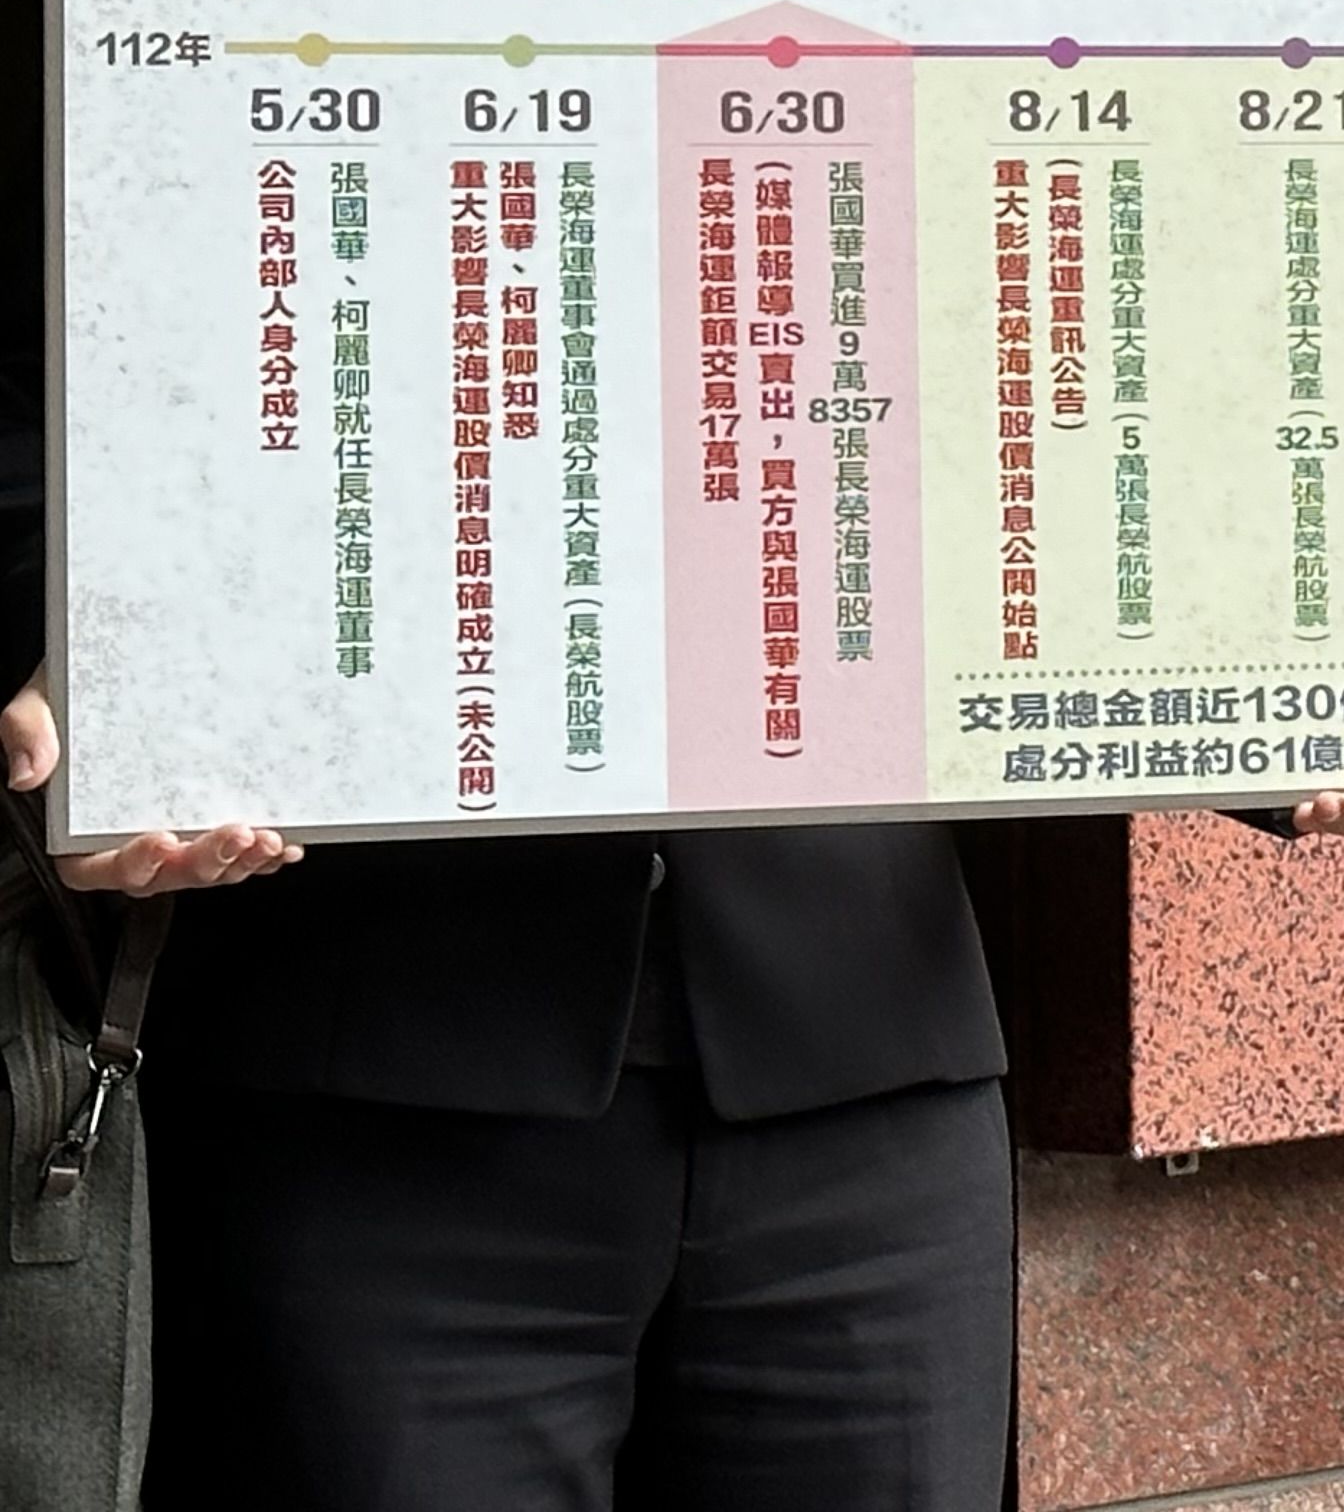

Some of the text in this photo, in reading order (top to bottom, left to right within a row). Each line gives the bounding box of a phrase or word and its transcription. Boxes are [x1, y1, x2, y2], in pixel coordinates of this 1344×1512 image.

[97, 31, 212, 67] 112年
[250, 88, 381, 133] 5/30
[463, 88, 593, 133] 6/19
[721, 90, 844, 134] 6/30
[1009, 89, 1132, 133] 8/14
[258, 160, 299, 451] 公司內部人身分成立
[331, 162, 374, 678] 張國華、柯麗卿就任長榮海運董事
[500, 161, 539, 440] 張國華、柯麗卿知悉
[699, 158, 741, 503] 長榮海運鉅額交易17萬張
[808, 161, 892, 662] 張國華買進9萬8357張長榮海運股票
[993, 159, 1038, 661] 重大影響長榮海運股價消息公開始點
